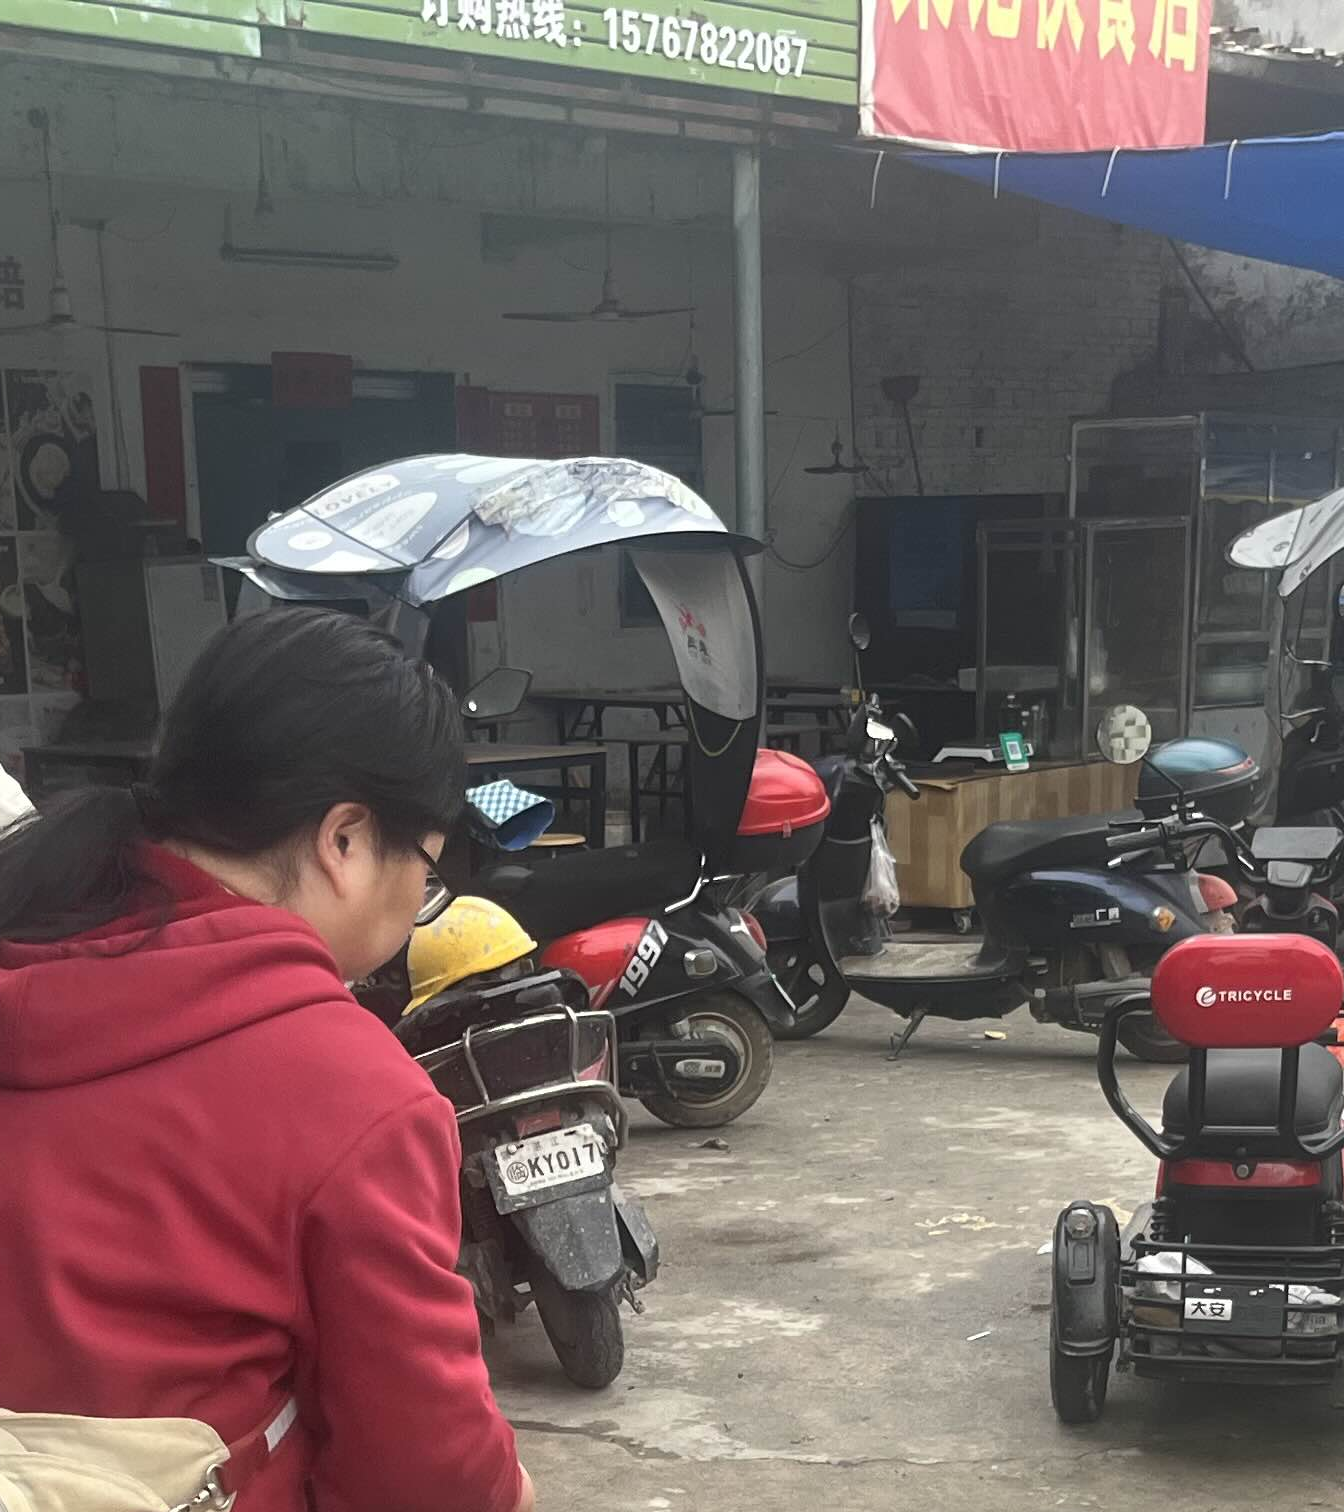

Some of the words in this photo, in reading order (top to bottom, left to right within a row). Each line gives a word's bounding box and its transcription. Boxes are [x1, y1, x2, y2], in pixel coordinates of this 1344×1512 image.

[619, 919, 669, 998] 1997
[1218, 988, 1293, 1003] TRICYCLE
[1191, 1300, 1225, 1318] 大安
